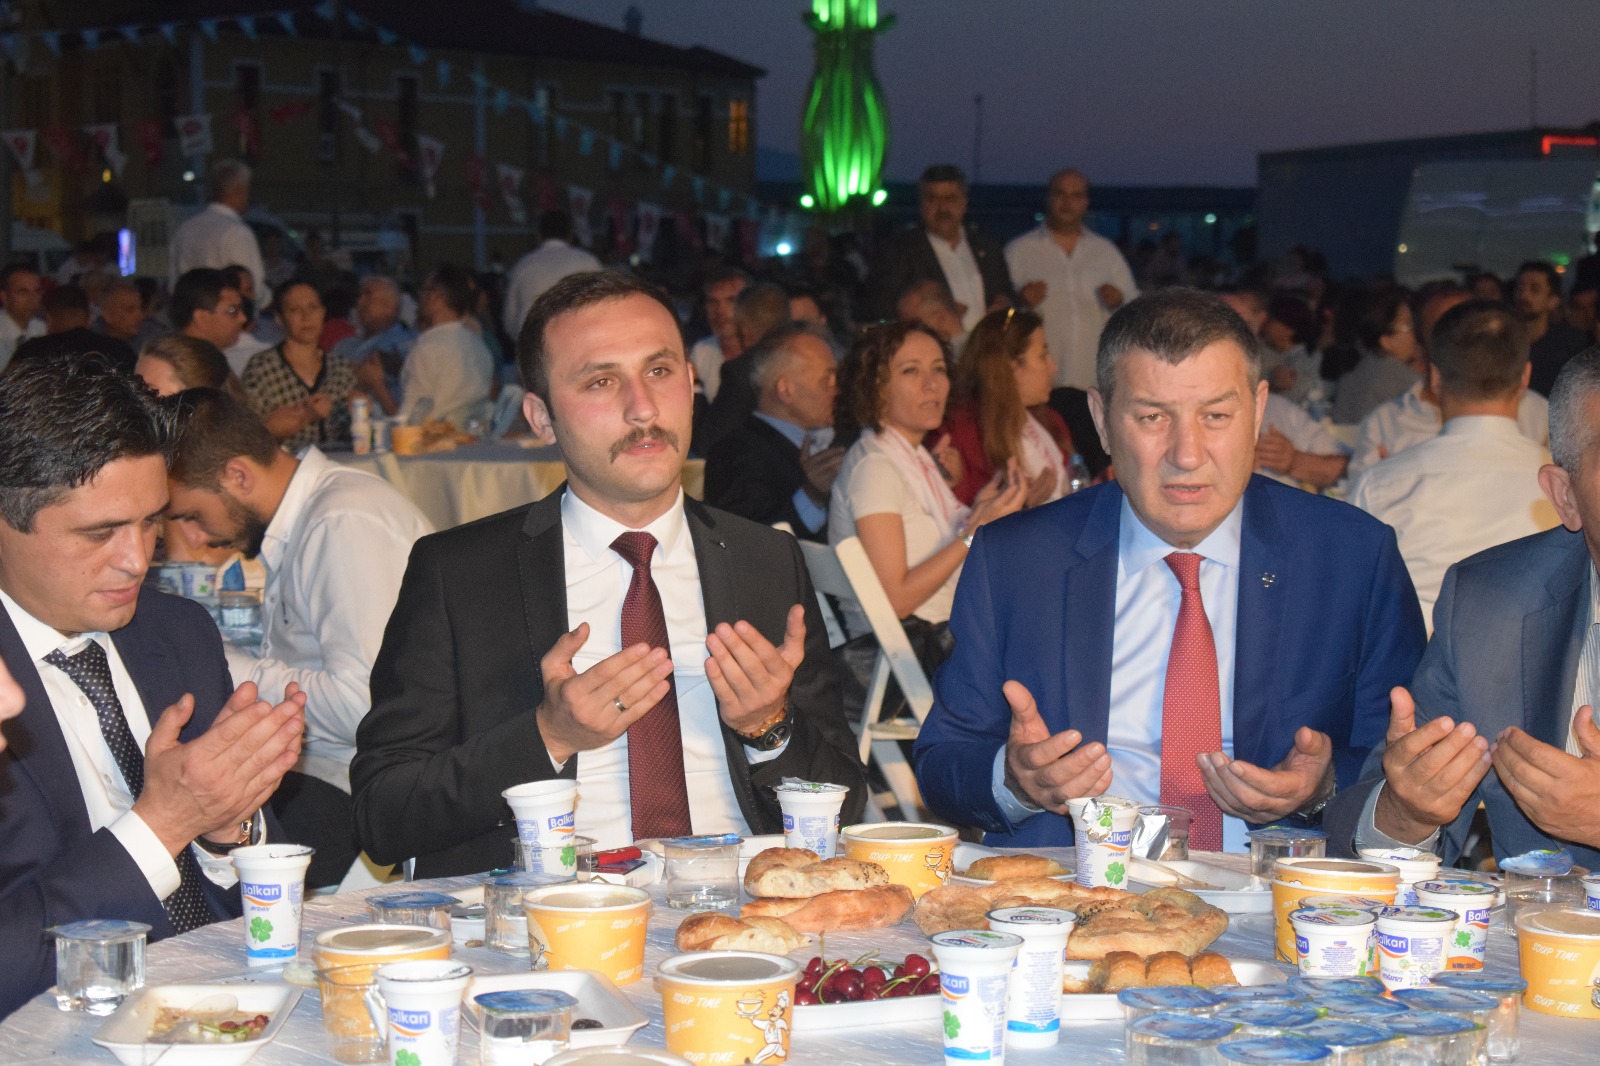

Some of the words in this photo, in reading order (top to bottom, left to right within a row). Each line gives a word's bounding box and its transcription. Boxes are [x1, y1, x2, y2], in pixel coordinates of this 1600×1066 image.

[868, 852, 891, 862] SOUP
[893, 853, 915, 863] TIME
[610, 918, 633, 929] SOUP
[1532, 943, 1555, 955] SOUP
[1556, 949, 1582, 962] TIME
[673, 992, 695, 1005] SOUP
[696, 997, 723, 1009] TIME
[1533, 994, 1555, 1008] SOUP
[1557, 1001, 1583, 1013] TIME
[683, 1050, 707, 1063] SOUP
[707, 1050, 736, 1064] TIME
